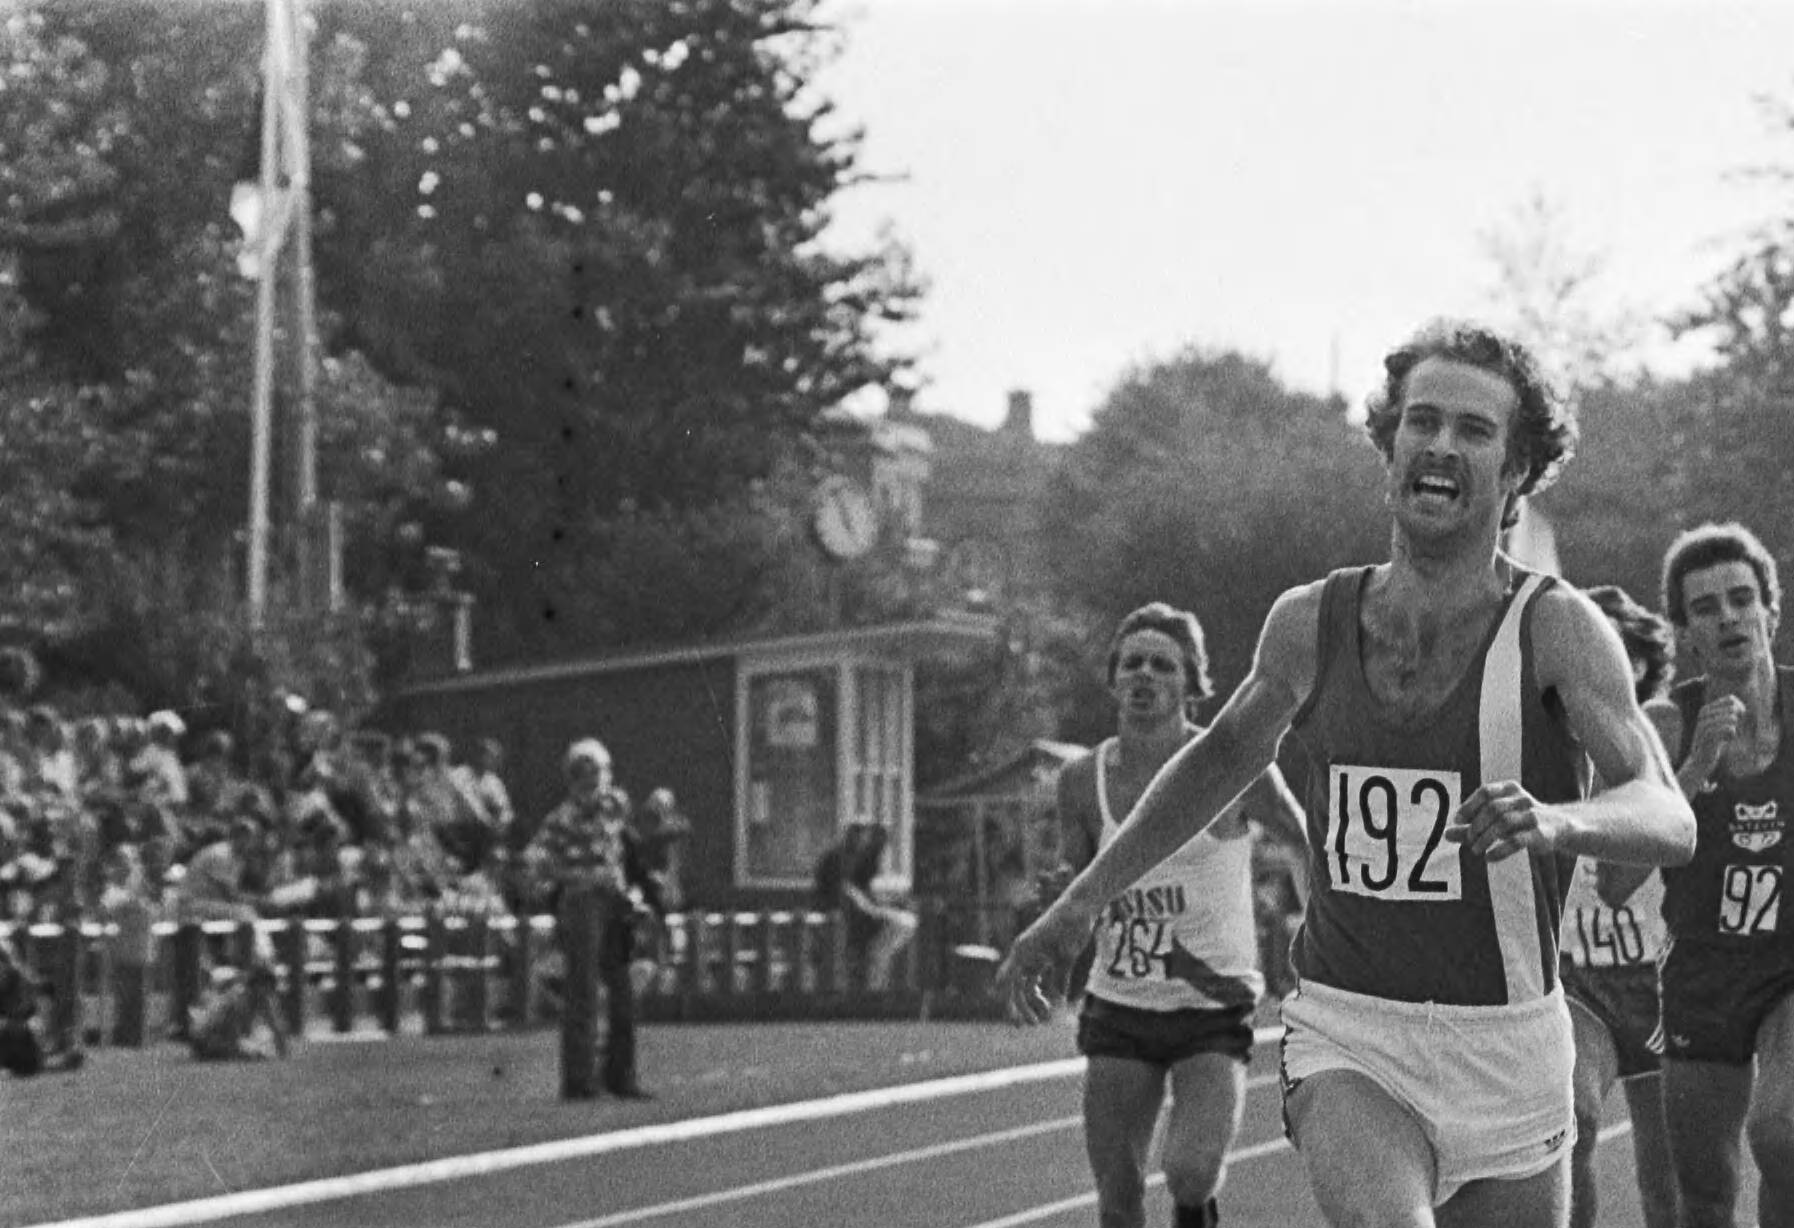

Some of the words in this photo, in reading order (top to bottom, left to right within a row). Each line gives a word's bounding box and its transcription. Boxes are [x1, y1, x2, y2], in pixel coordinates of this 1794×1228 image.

[1335, 772, 1450, 892] 192
[1720, 865, 1784, 934] 92
[1576, 904, 1645, 967] 140
